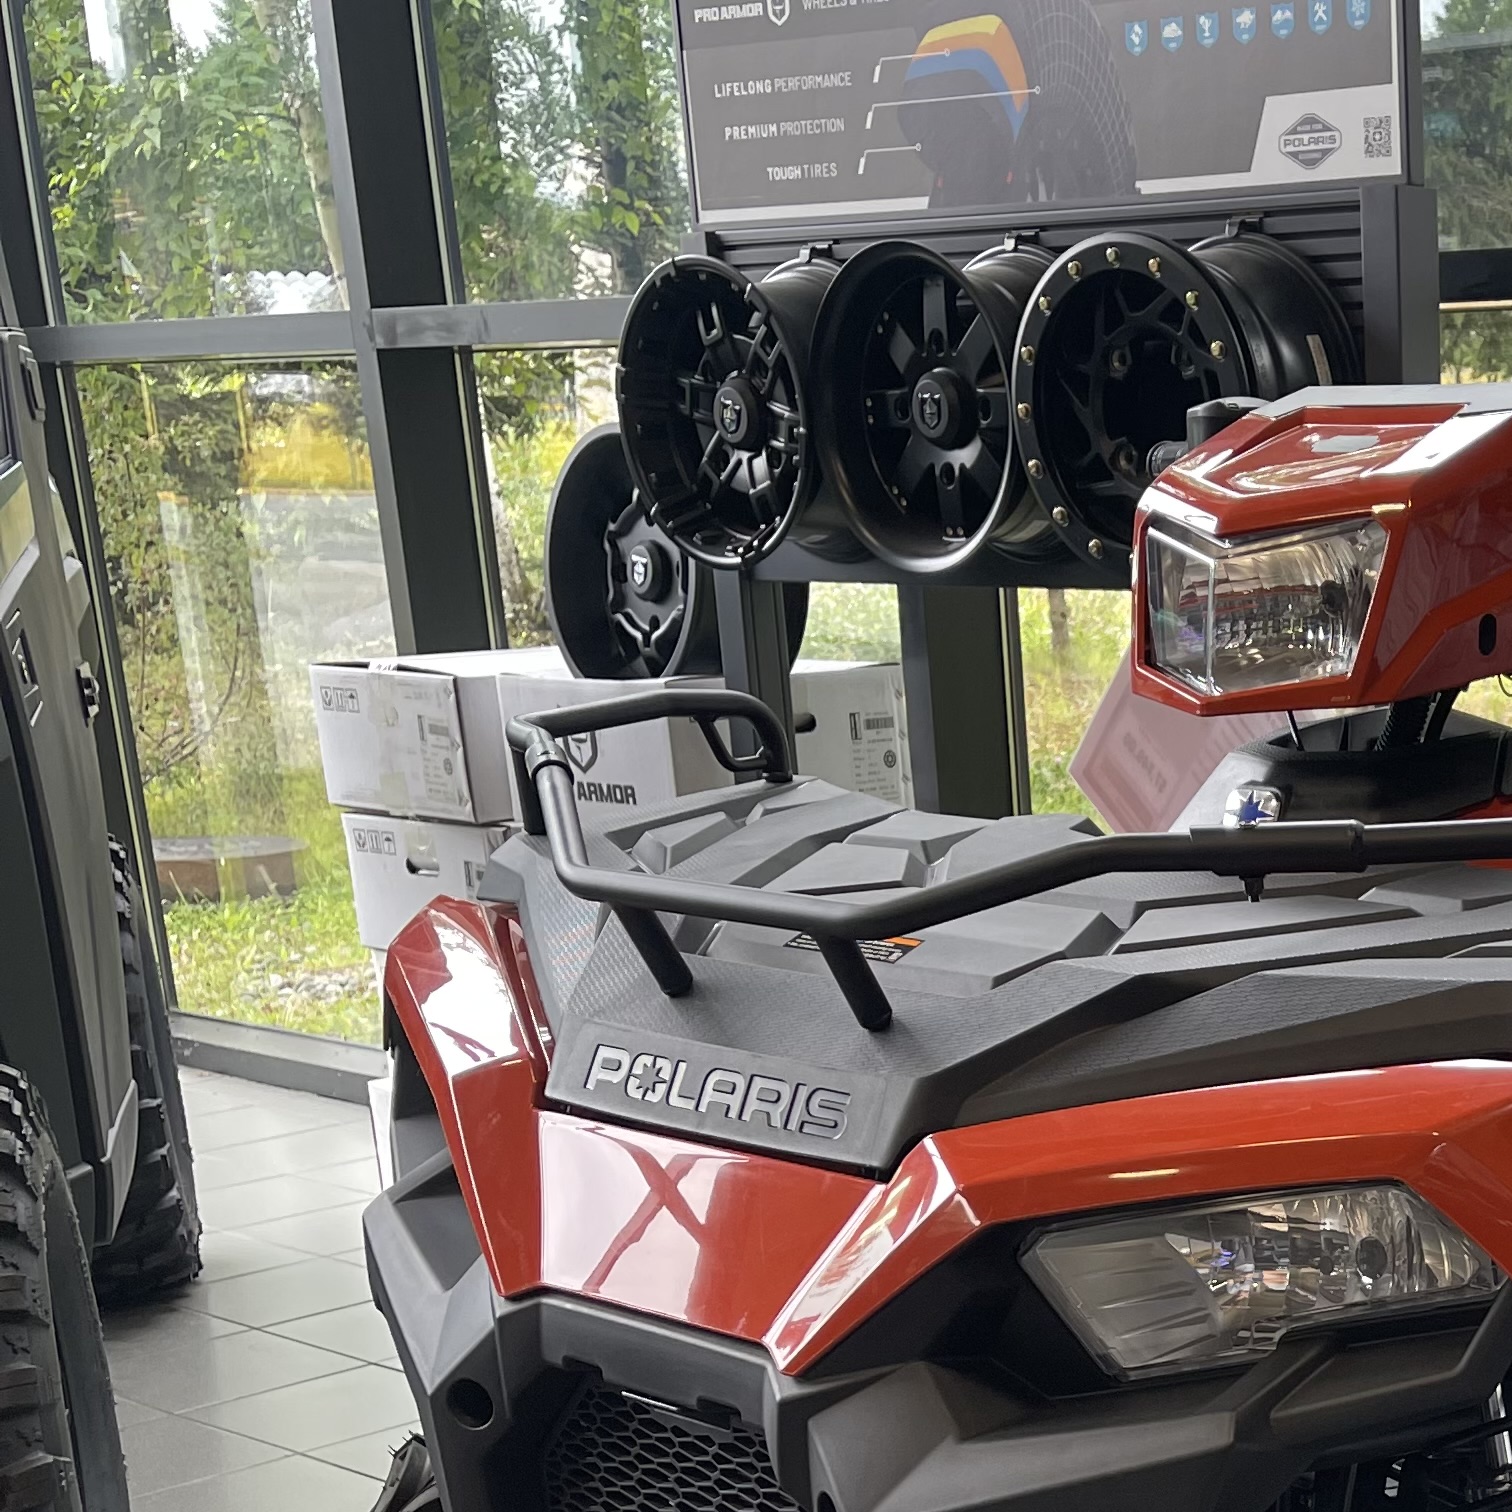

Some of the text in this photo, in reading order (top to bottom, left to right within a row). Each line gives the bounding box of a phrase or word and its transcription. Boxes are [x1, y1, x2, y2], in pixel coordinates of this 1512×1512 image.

[714, 72, 852, 98] LIFELONG PERFORMANCE
[724, 117, 845, 140] PREMIUM PROTECTION
[1283, 134, 1337, 149] POLARIS
[767, 162, 838, 181] TOUGH TIRES
[577, 781, 637, 806] ARMOR
[583, 1043, 851, 1140] POLARIS
